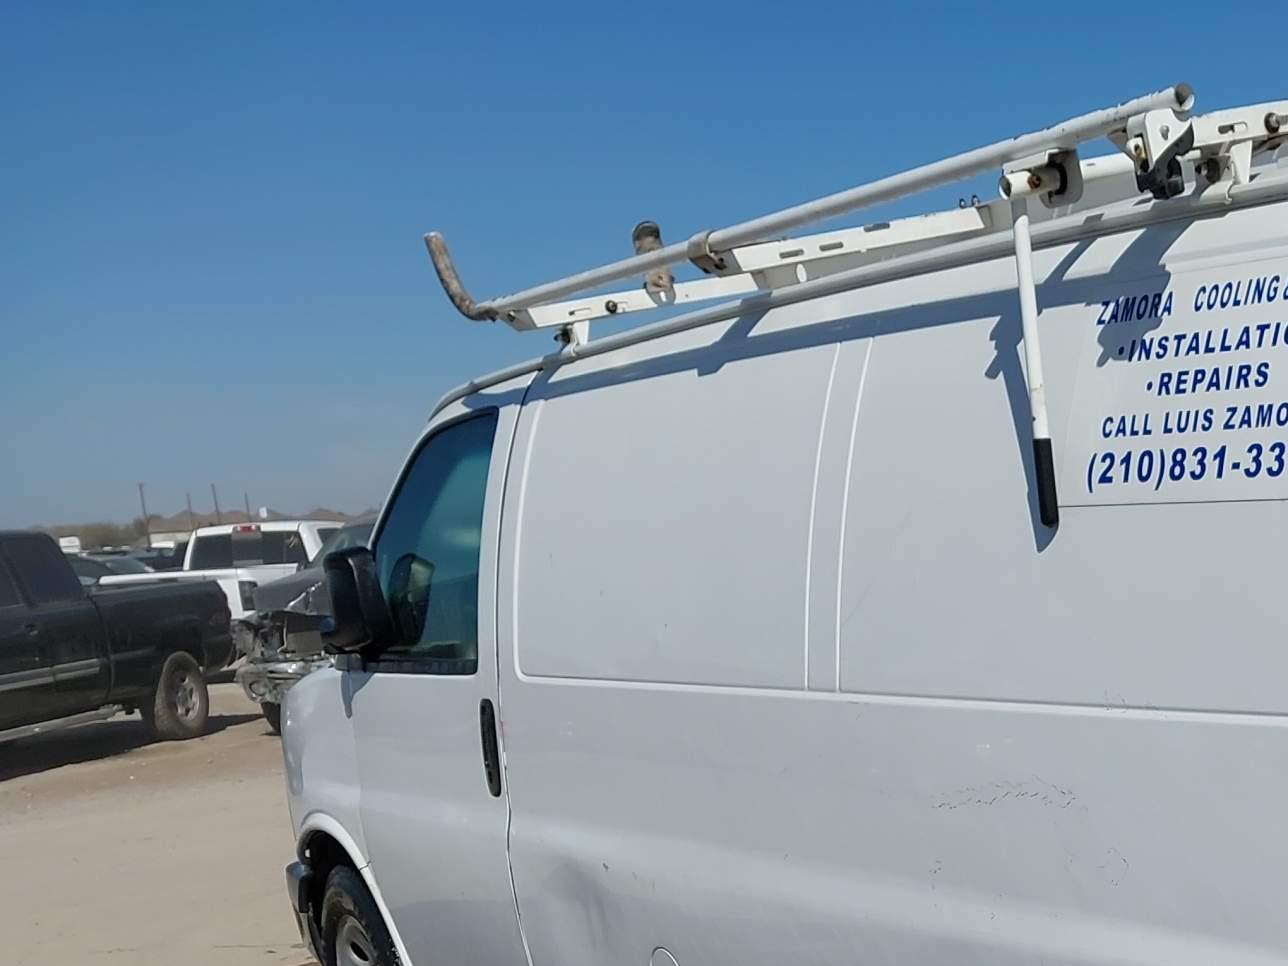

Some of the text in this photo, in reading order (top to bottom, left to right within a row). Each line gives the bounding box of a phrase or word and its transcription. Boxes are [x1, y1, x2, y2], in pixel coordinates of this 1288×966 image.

[1096, 291, 1173, 326] ZAMORA
[1102, 413, 1152, 438] CALL
[1163, 409, 1213, 434] LUIS
